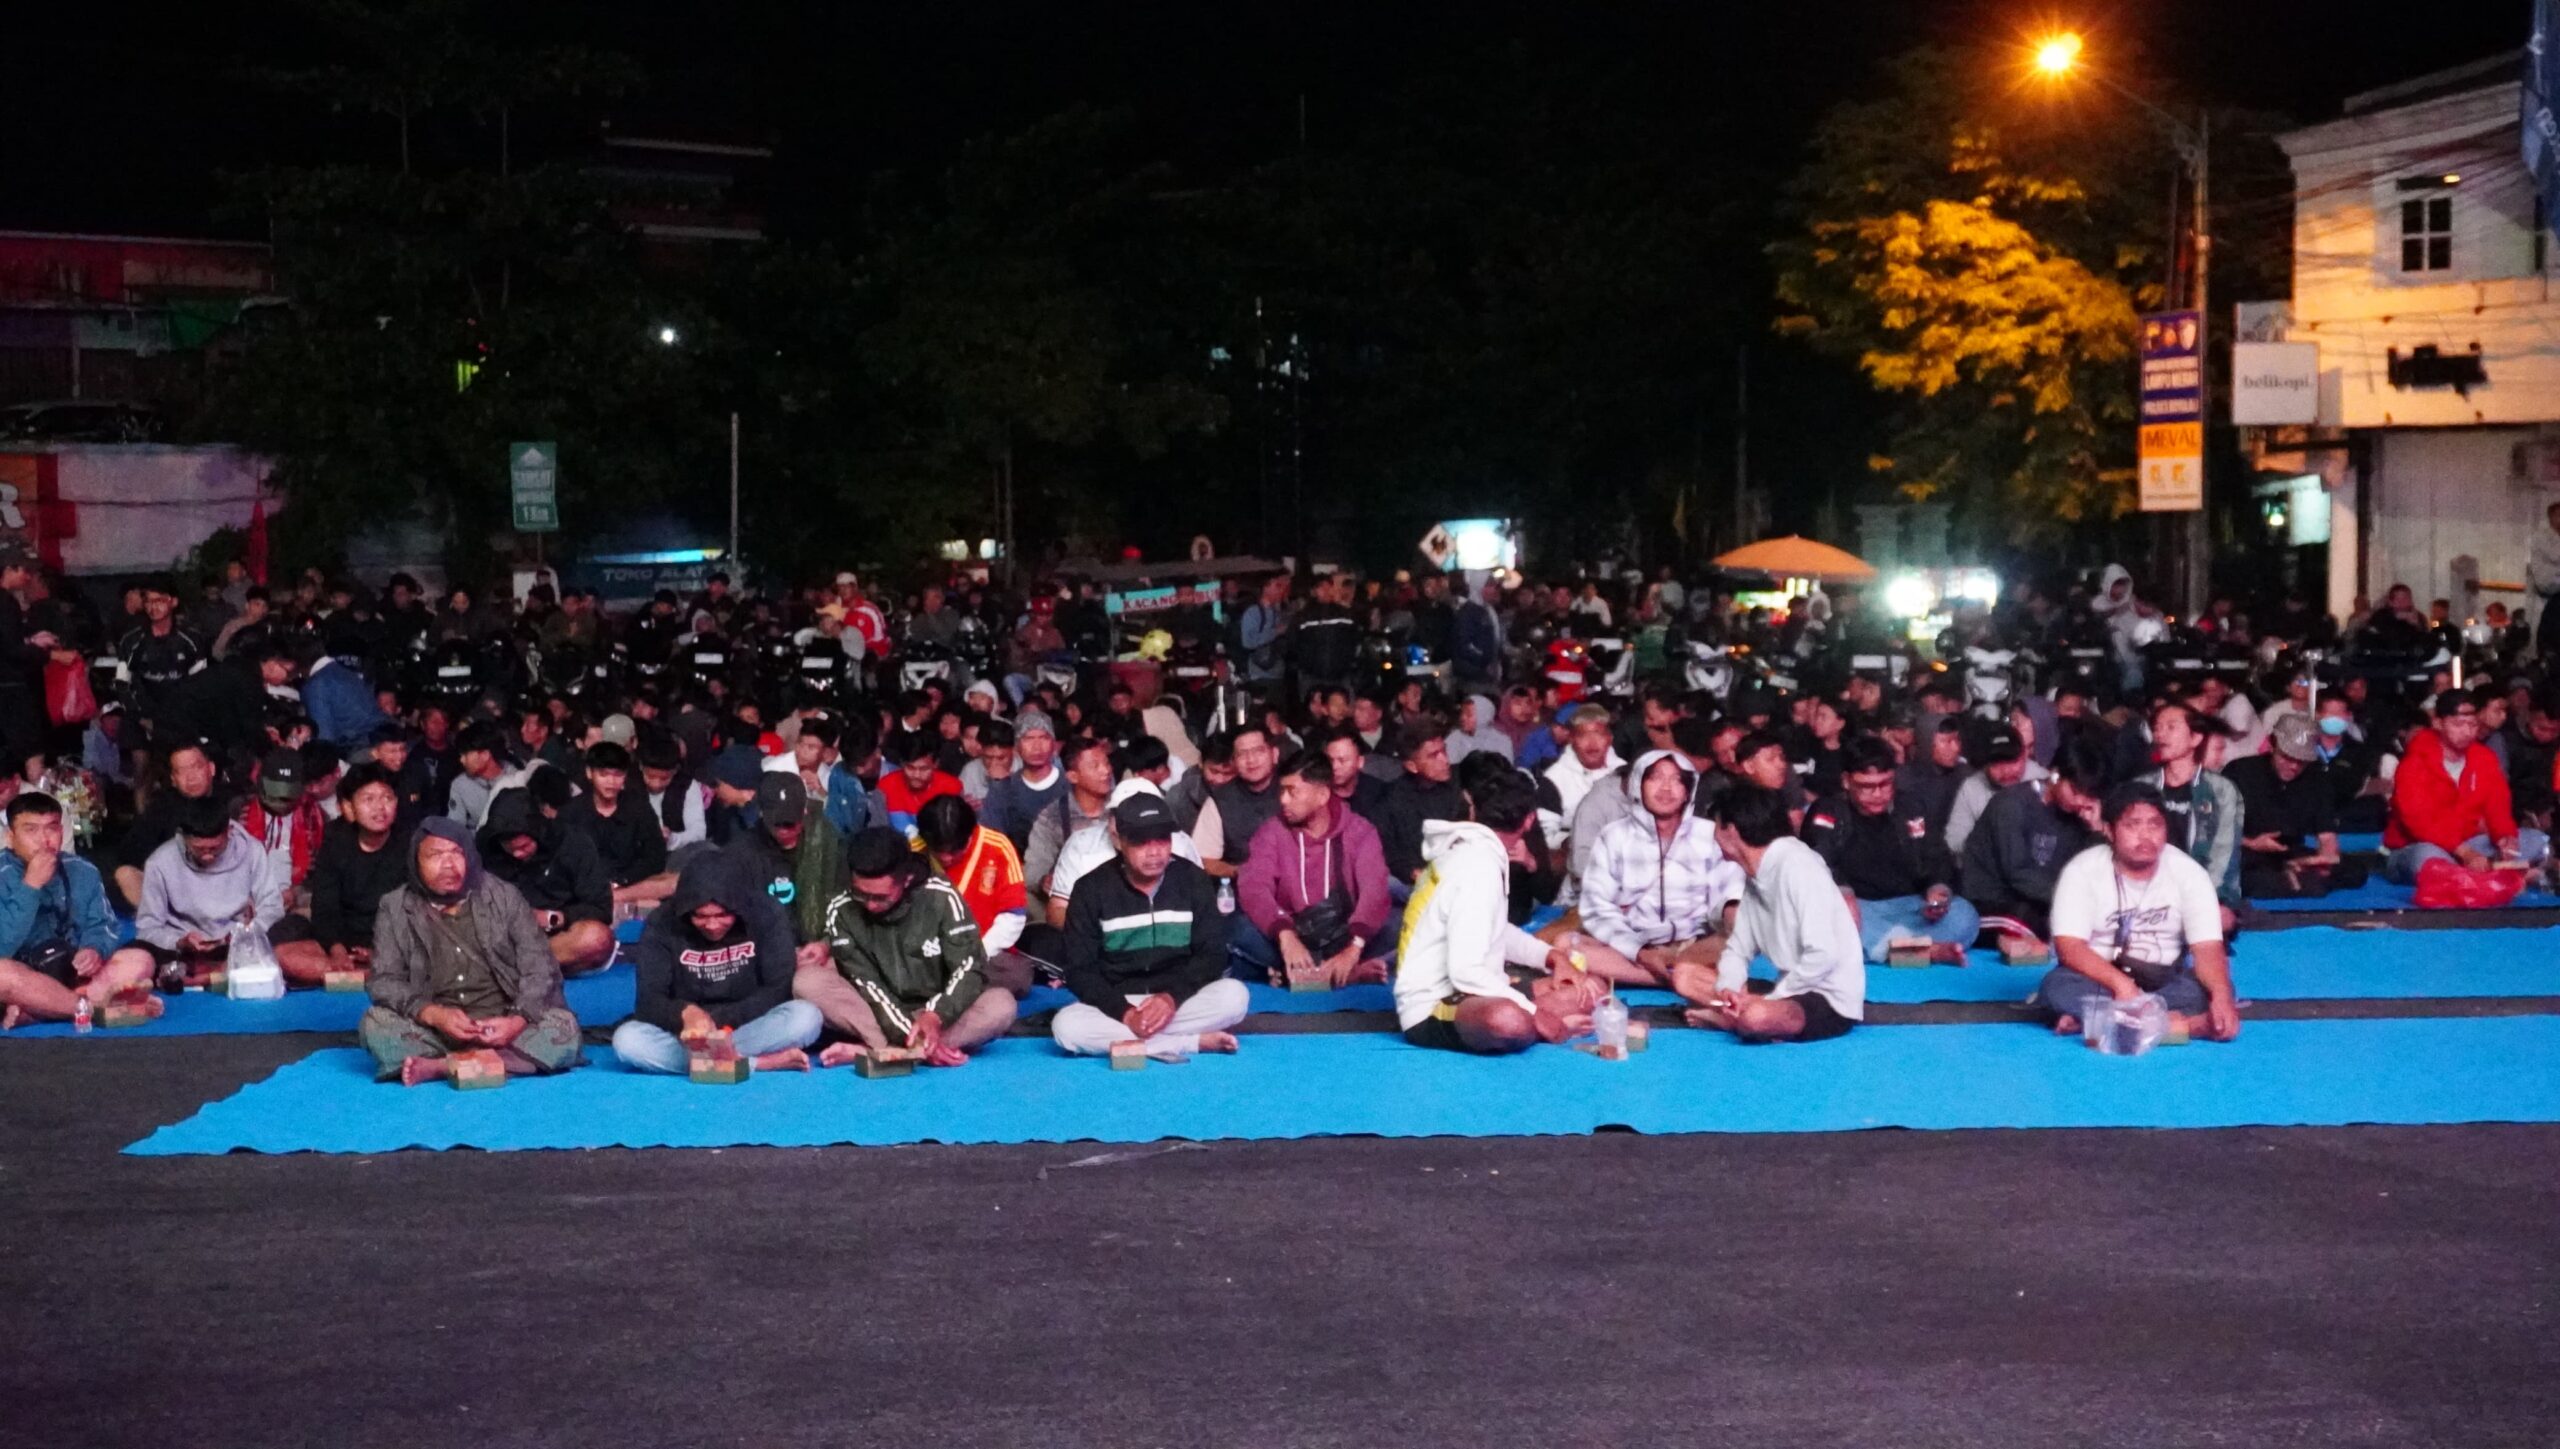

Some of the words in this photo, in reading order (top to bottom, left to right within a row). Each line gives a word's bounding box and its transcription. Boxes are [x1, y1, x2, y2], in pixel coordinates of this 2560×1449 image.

[2243, 374, 2309, 391] belikopi
[2144, 430, 2198, 447] MEVAL
[602, 567, 654, 582] TOKO
[680, 941, 755, 966] EIGER
